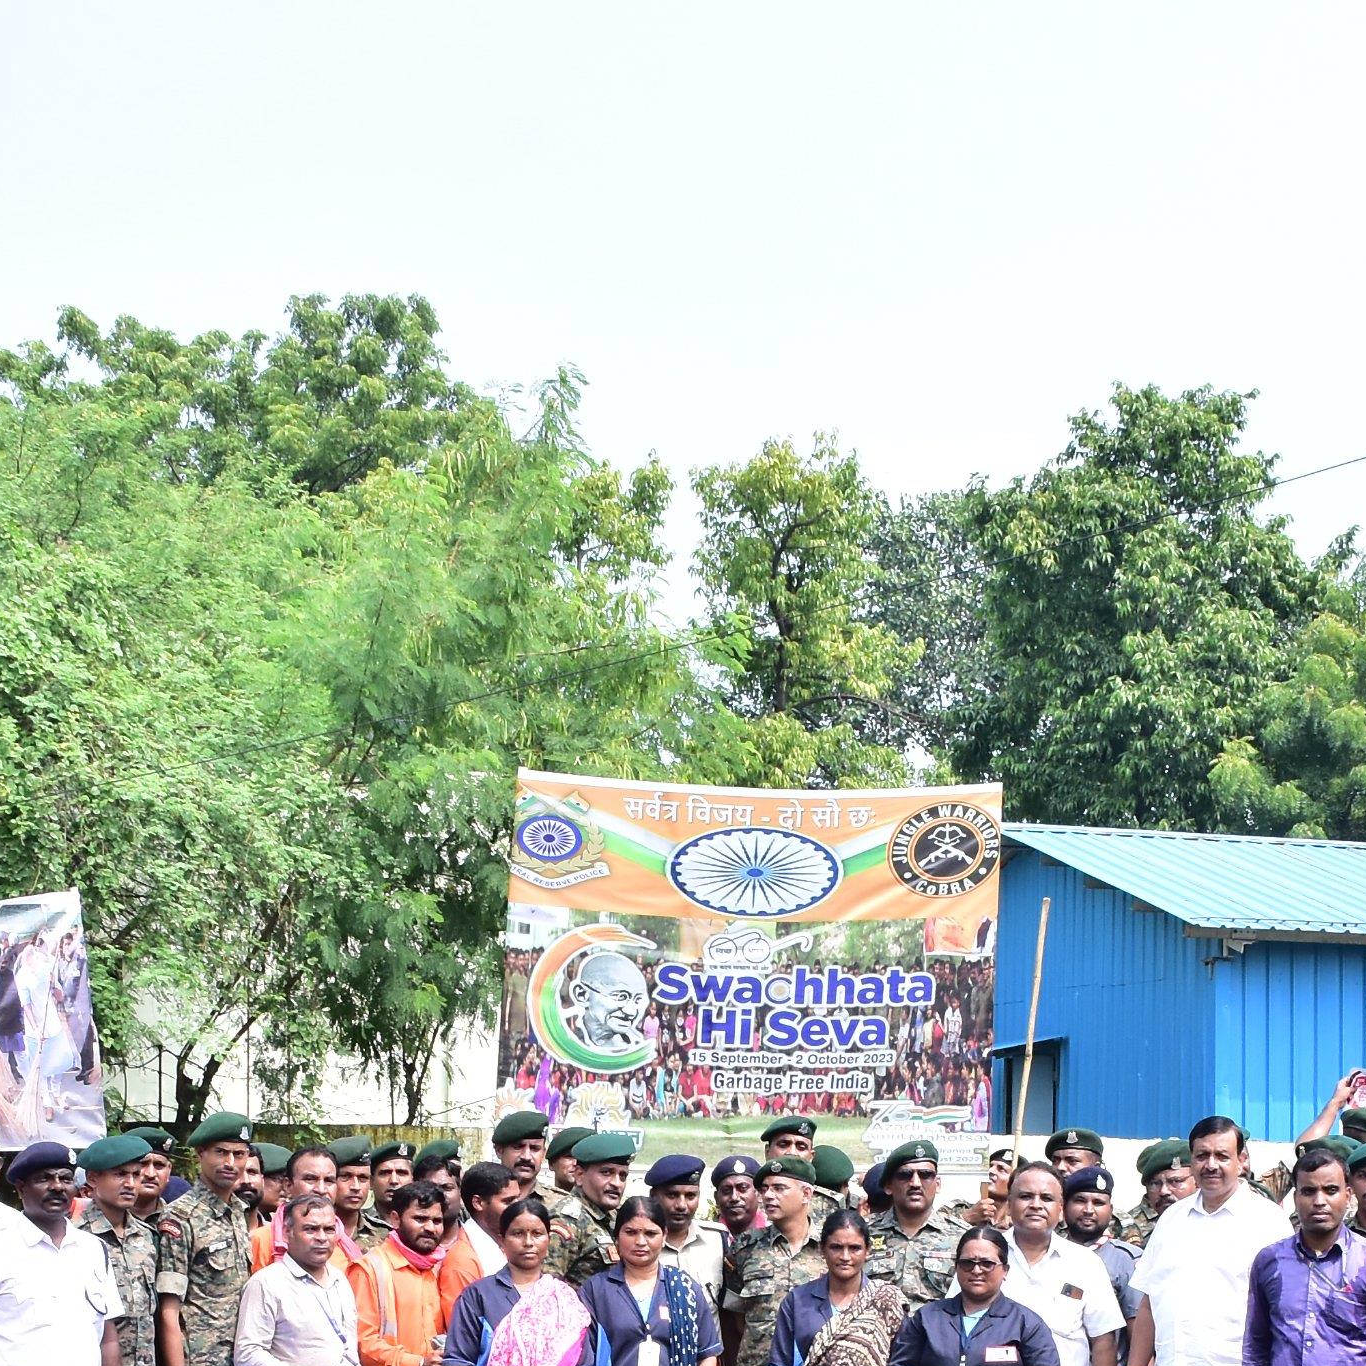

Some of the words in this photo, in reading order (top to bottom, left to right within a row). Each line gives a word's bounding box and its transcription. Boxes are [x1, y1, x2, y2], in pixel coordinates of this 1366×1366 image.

[623, 791, 679, 822] सर्वत्र
[686, 794, 754, 826] विजय
[778, 799, 804, 831] दो
[810, 798, 841, 828] सौ
[892, 810, 934, 864] JUNGLE
[938, 804, 999, 859] WARRIORS
[533, 877, 572, 887] RESERVE
[574, 868, 605, 881] POLICE
[656, 966, 934, 1005] Swachhata
[701, 1009, 752, 1045] Hi
[766, 1010, 886, 1046] Seva
[692, 1053, 706, 1062] 15
[711, 1053, 783, 1066] September
[795, 1055, 803, 1064] 2
[808, 1054, 859, 1064] October
[863, 1053, 894, 1064] 2023
[714, 1073, 782, 1092] Garbage
[789, 1074, 825, 1089] Free
[830, 1073, 869, 1089] India
